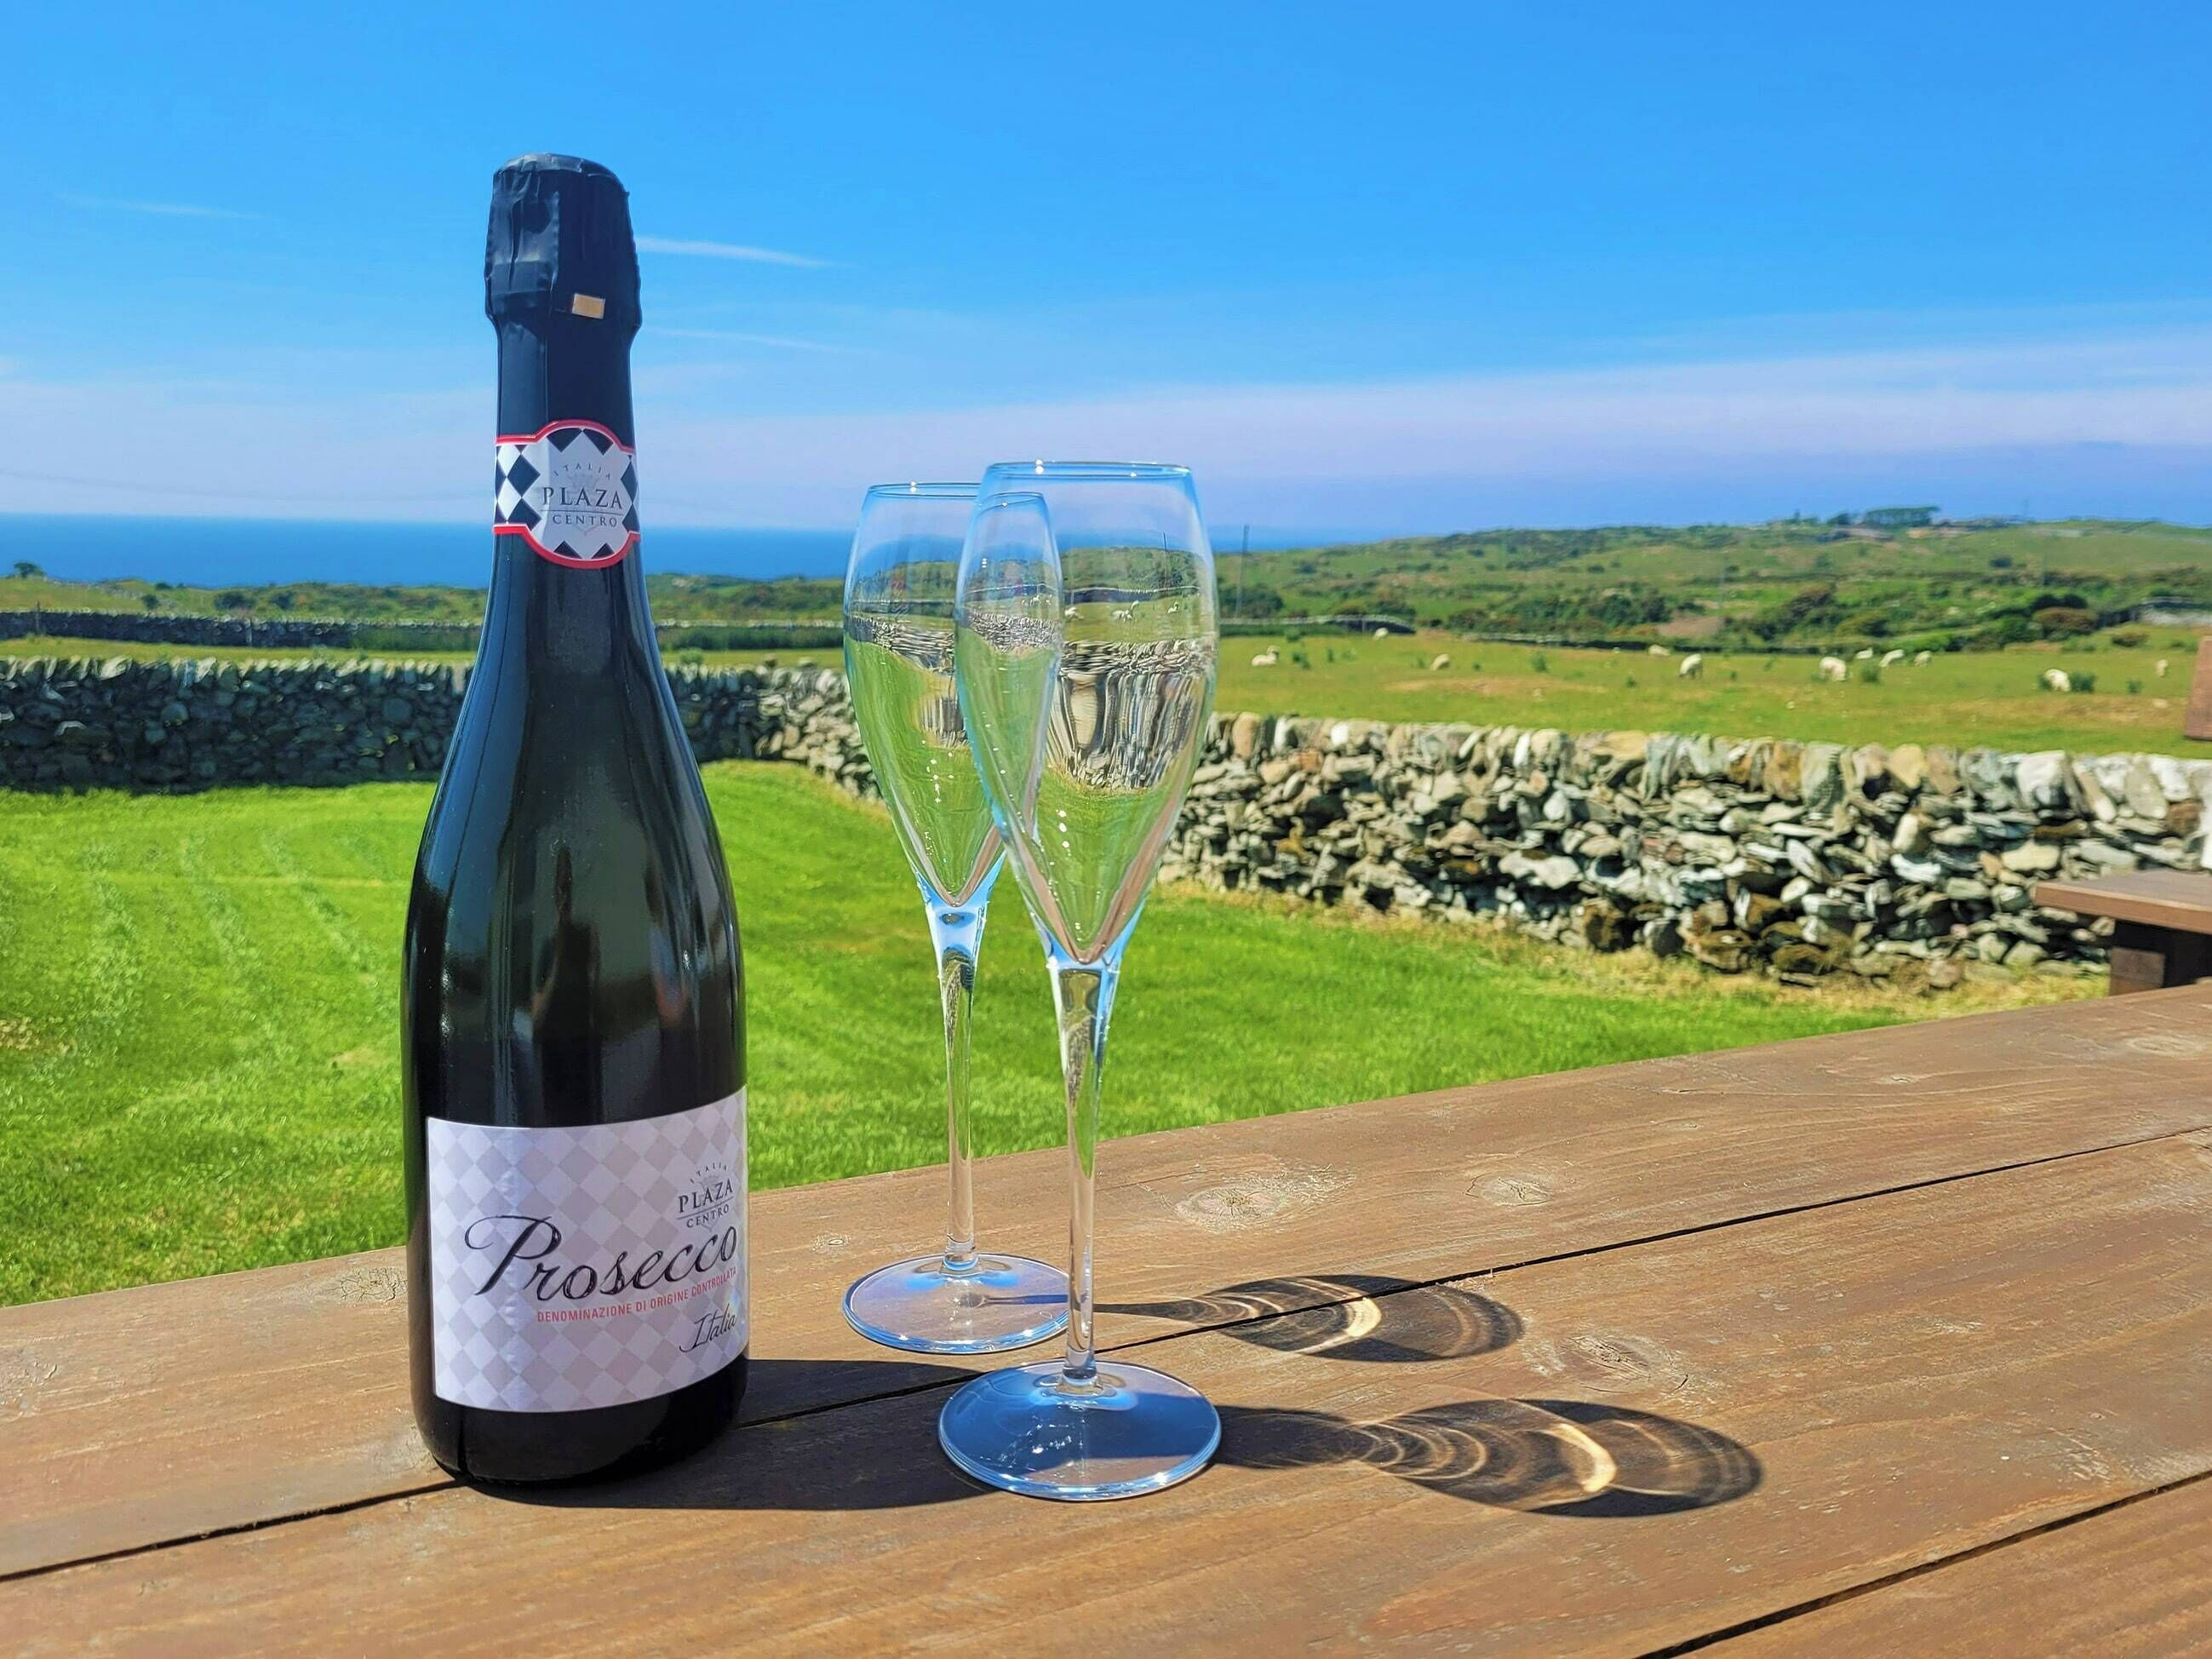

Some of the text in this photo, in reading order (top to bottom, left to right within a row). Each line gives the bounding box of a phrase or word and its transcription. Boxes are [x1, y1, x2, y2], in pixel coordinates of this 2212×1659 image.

[542, 486, 623, 510] PLAZA
[553, 514, 618, 528] CENTRO
[678, 1178, 733, 1214] PLAZA
[686, 1203, 730, 1228] CENTRO
[464, 1214, 738, 1300] Prosecco
[536, 1266, 737, 1323] DENOMINAZIONE DI ORIGINE CONTROLLATA
[679, 1303, 736, 1352] Italia
